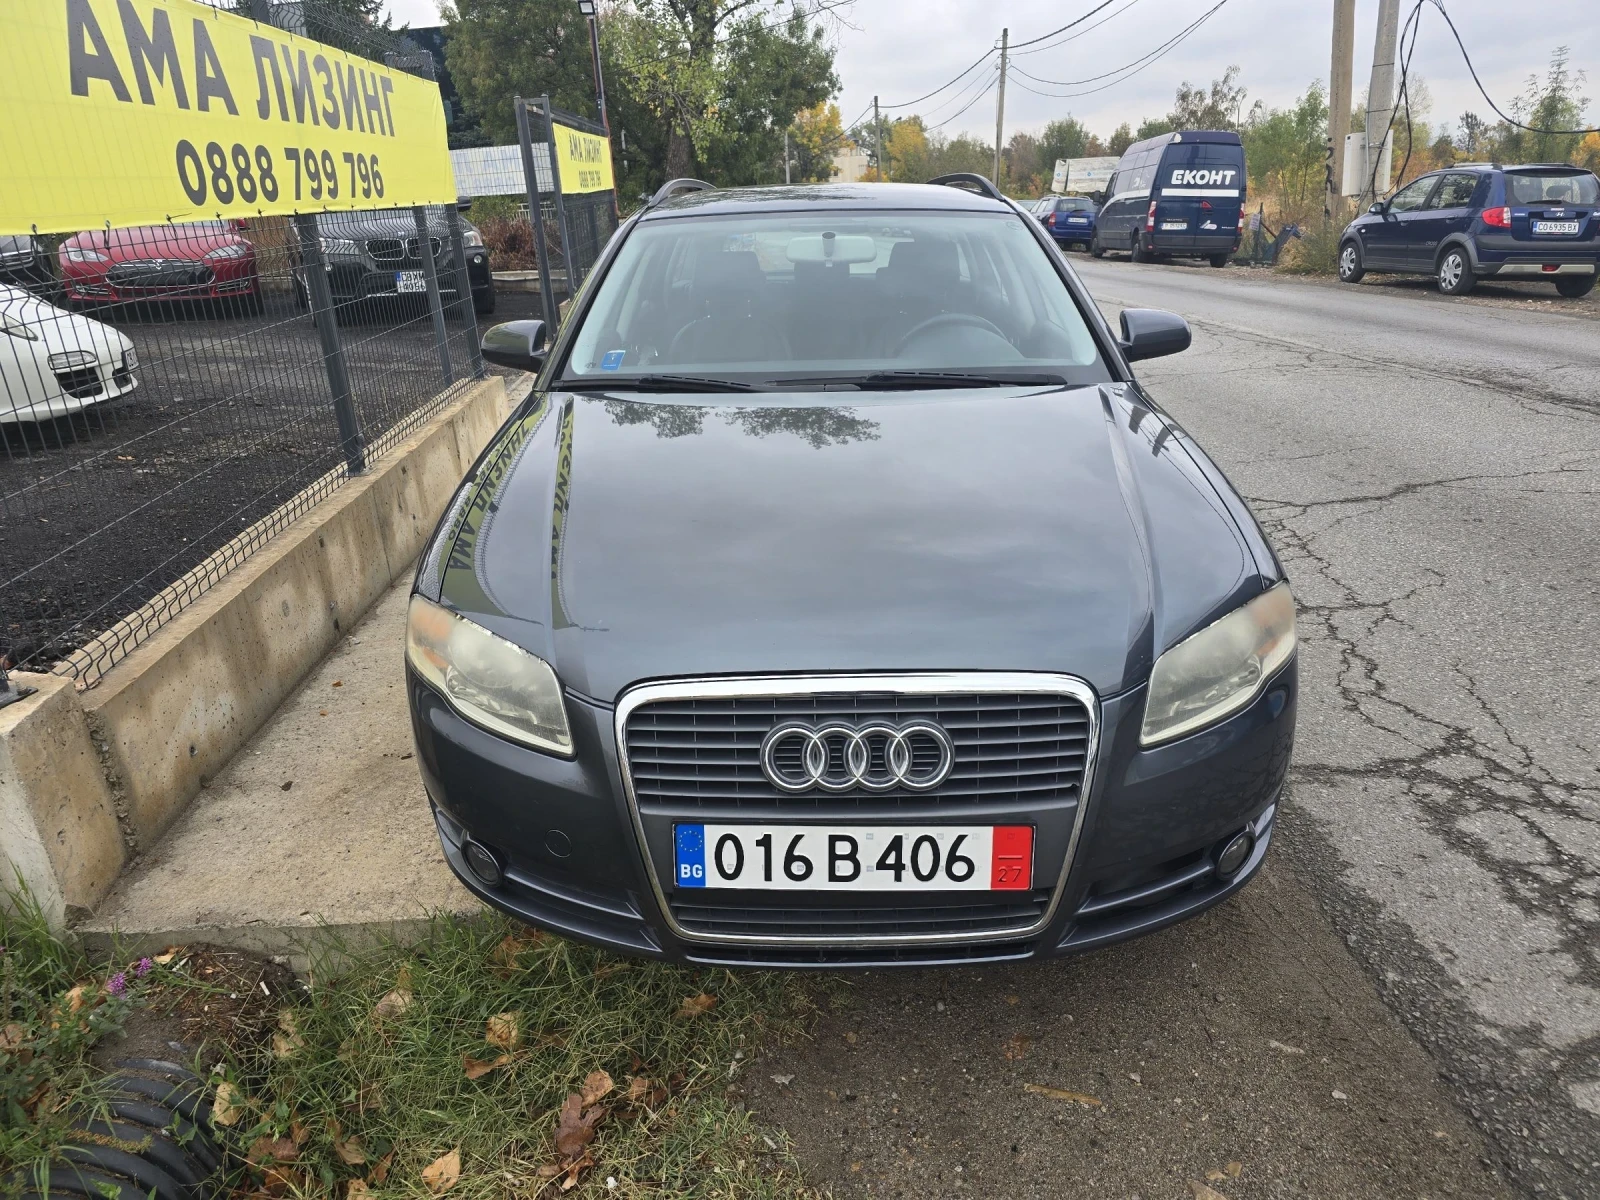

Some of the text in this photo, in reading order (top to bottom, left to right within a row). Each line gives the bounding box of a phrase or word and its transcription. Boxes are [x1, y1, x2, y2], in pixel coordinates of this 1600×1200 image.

[66, 0, 396, 137] АМА ЛИЗИНГ
[569, 133, 584, 162] АМА
[176, 139, 385, 206] 0888 799 796
[1170, 169, 1236, 186] ЕКОНТ
[680, 863, 703, 878] BG
[998, 866, 1022, 882] 27
